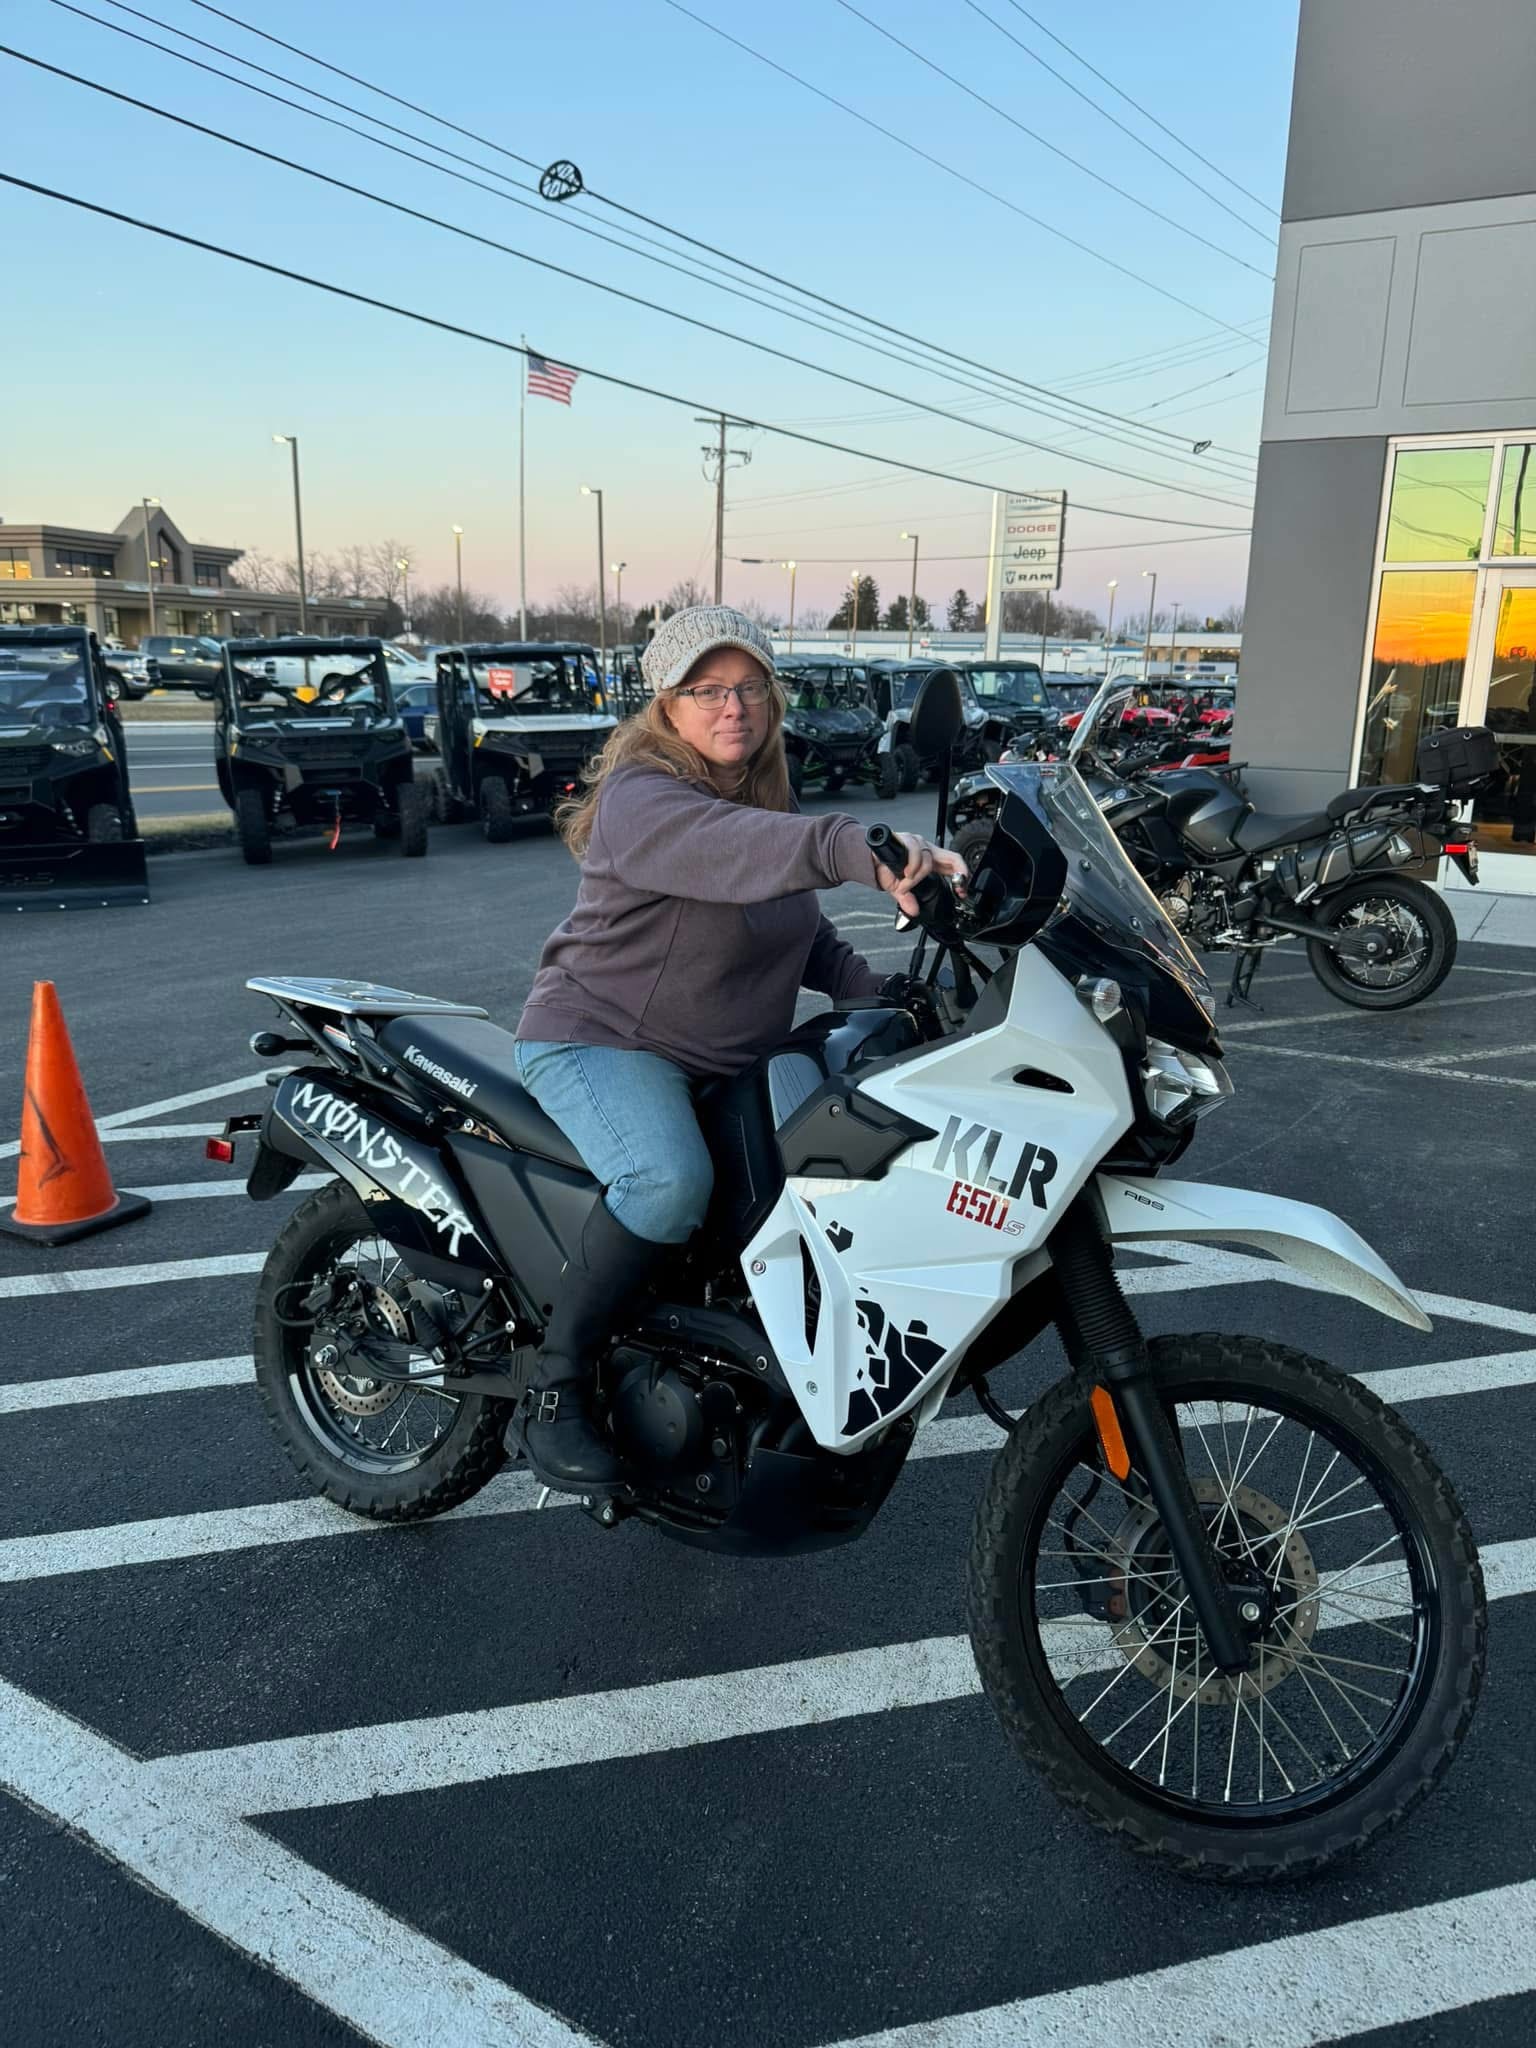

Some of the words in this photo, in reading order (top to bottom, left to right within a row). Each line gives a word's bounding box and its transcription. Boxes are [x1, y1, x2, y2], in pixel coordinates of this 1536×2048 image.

[1007, 524, 1057, 534] DODGE
[1014, 545, 1046, 561] Jeep
[1018, 573, 1054, 581] RAM
[403, 1045, 478, 1098] Kawasaki
[932, 1114, 1058, 1210] KLR
[1124, 1190, 1165, 1211] ABS
